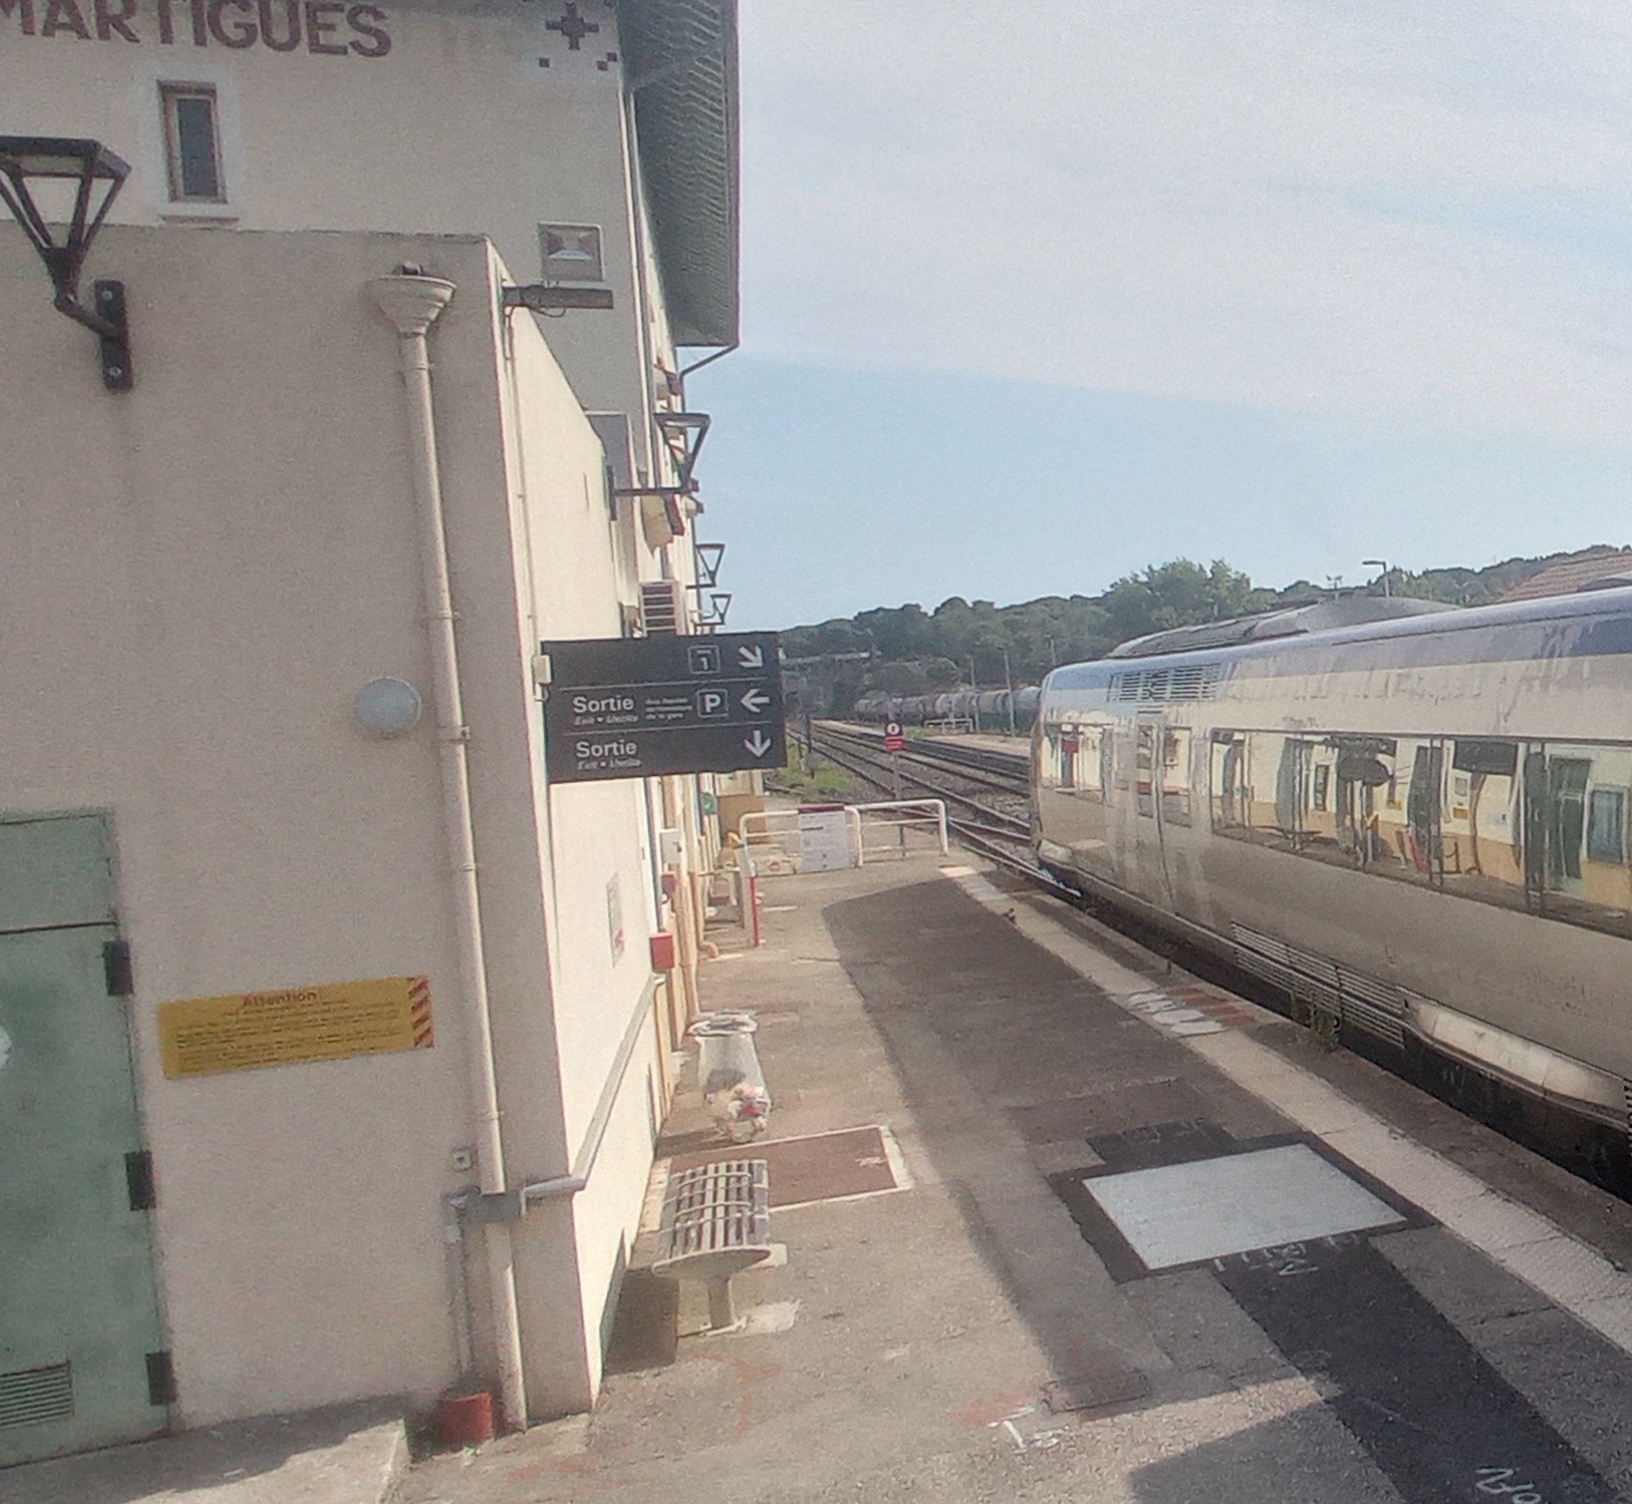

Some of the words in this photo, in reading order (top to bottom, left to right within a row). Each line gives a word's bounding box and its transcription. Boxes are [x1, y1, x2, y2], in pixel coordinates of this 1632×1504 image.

[700, 656, 709, 670] 1
[572, 694, 634, 714] Sortie
[705, 694, 721, 713] P
[576, 739, 637, 758] Sortie
